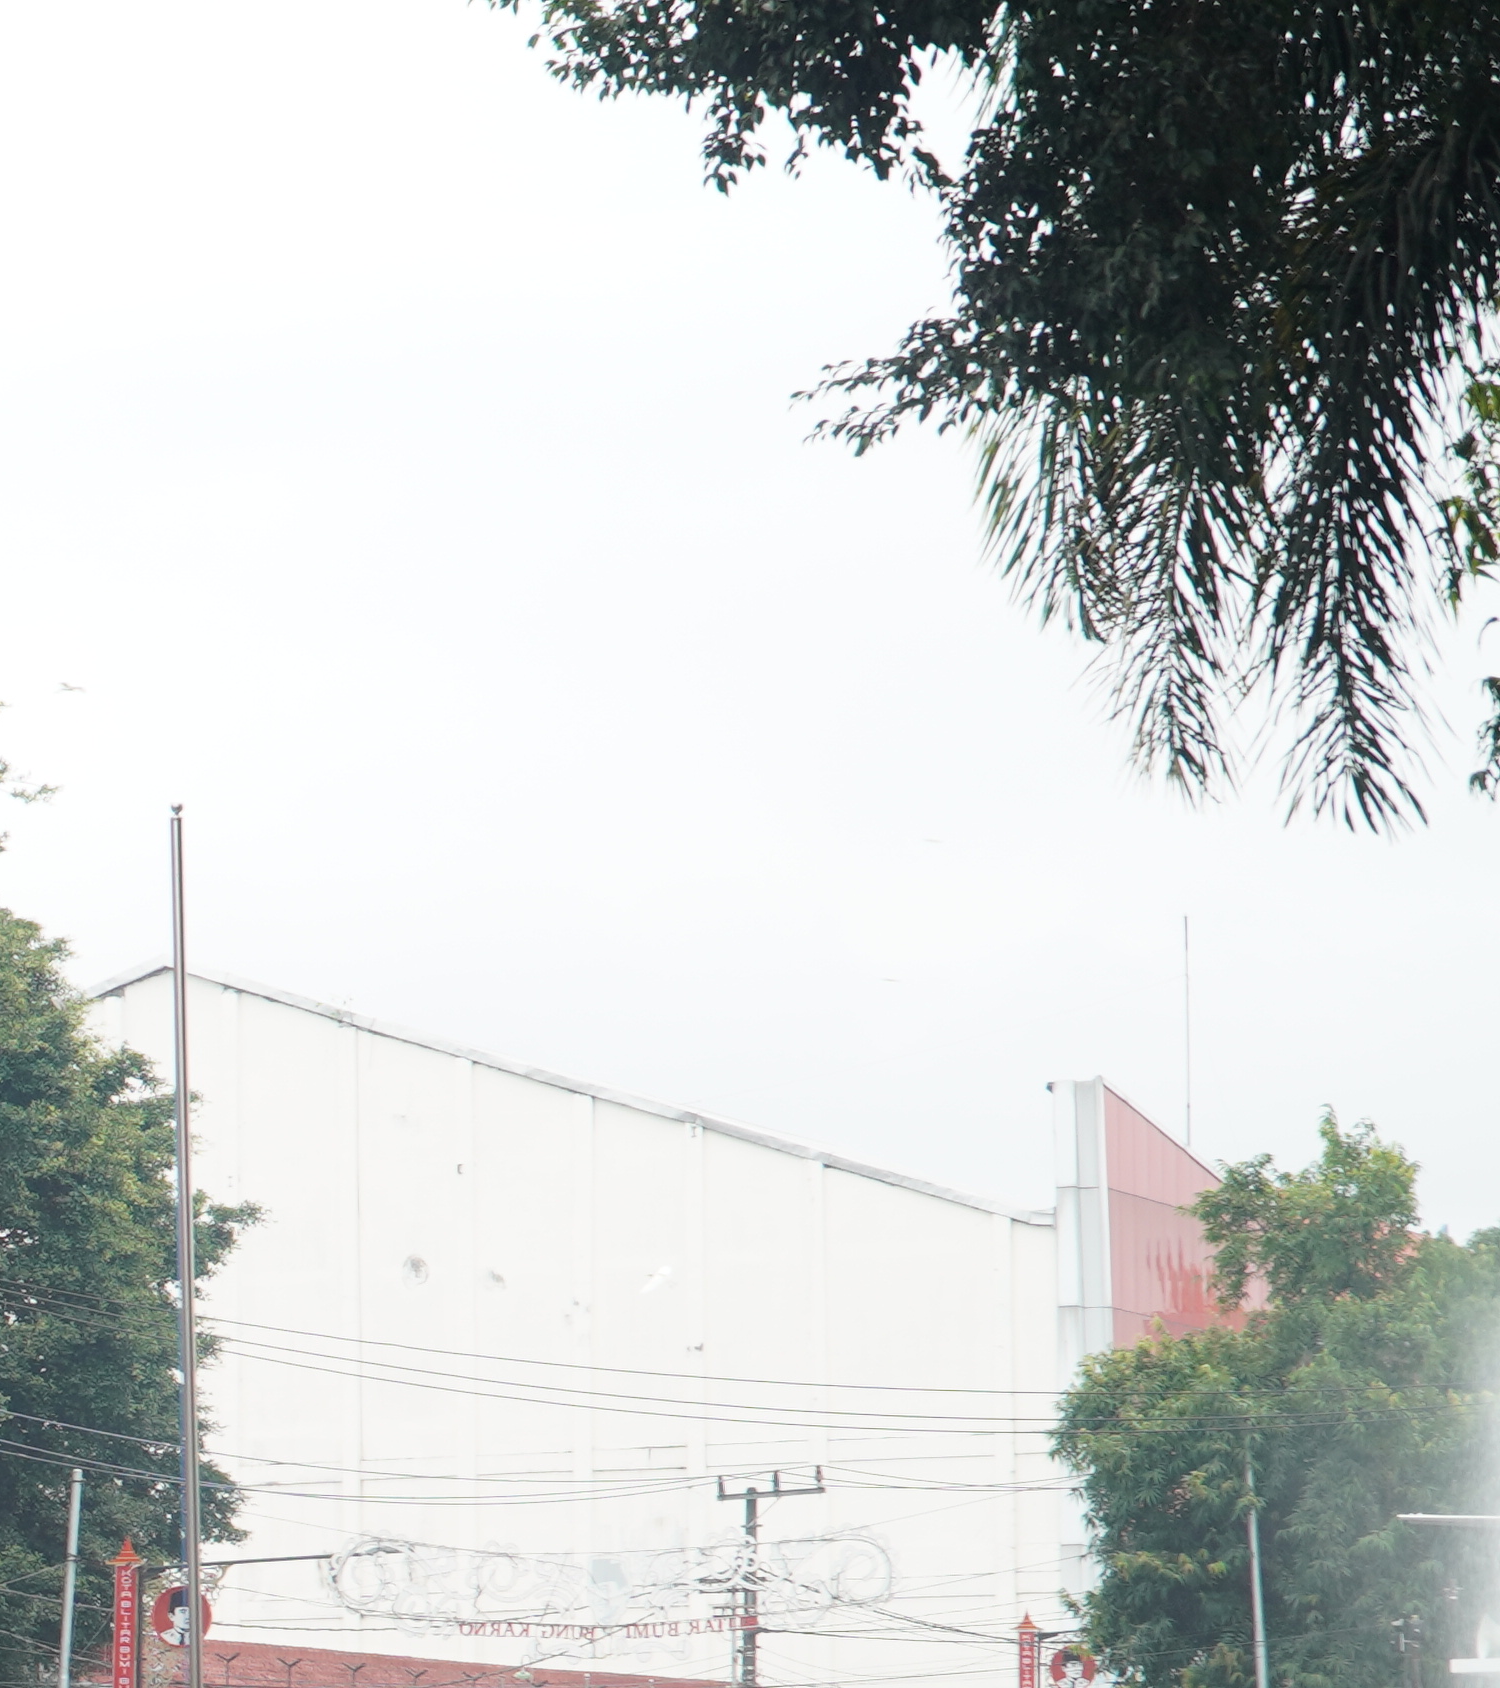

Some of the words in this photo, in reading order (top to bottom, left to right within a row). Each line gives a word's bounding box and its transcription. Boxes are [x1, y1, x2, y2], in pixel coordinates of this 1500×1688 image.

[120, 1569, 133, 1598] KOTA
[120, 1602, 132, 1644] BLITAR
[119, 1646, 131, 1675] BUMI
